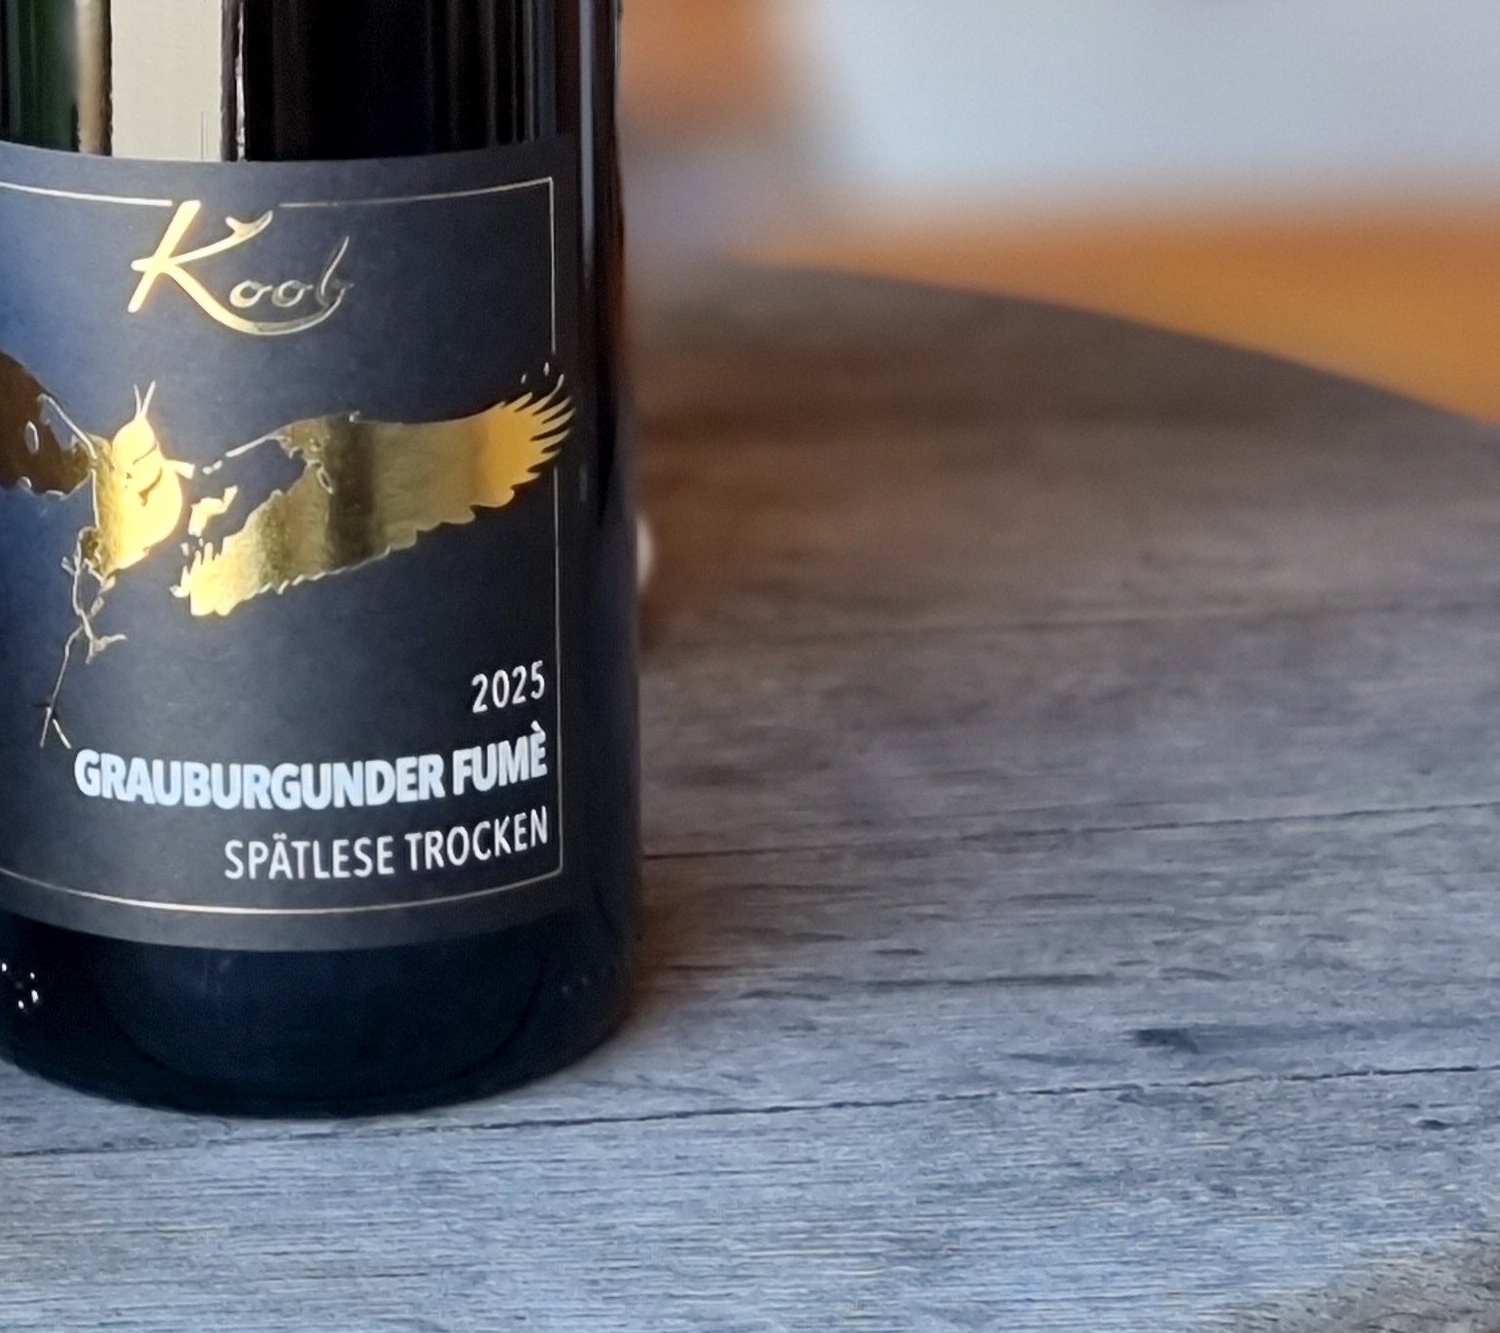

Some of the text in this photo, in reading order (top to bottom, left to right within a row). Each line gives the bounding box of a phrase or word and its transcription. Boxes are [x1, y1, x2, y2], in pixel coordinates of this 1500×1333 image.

[127, 199, 354, 335] Koob
[471, 660, 546, 713] 2025
[73, 747, 444, 810] GRAUBURGUNDER
[224, 805, 549, 880] SPÄTLESE TROCKEN
